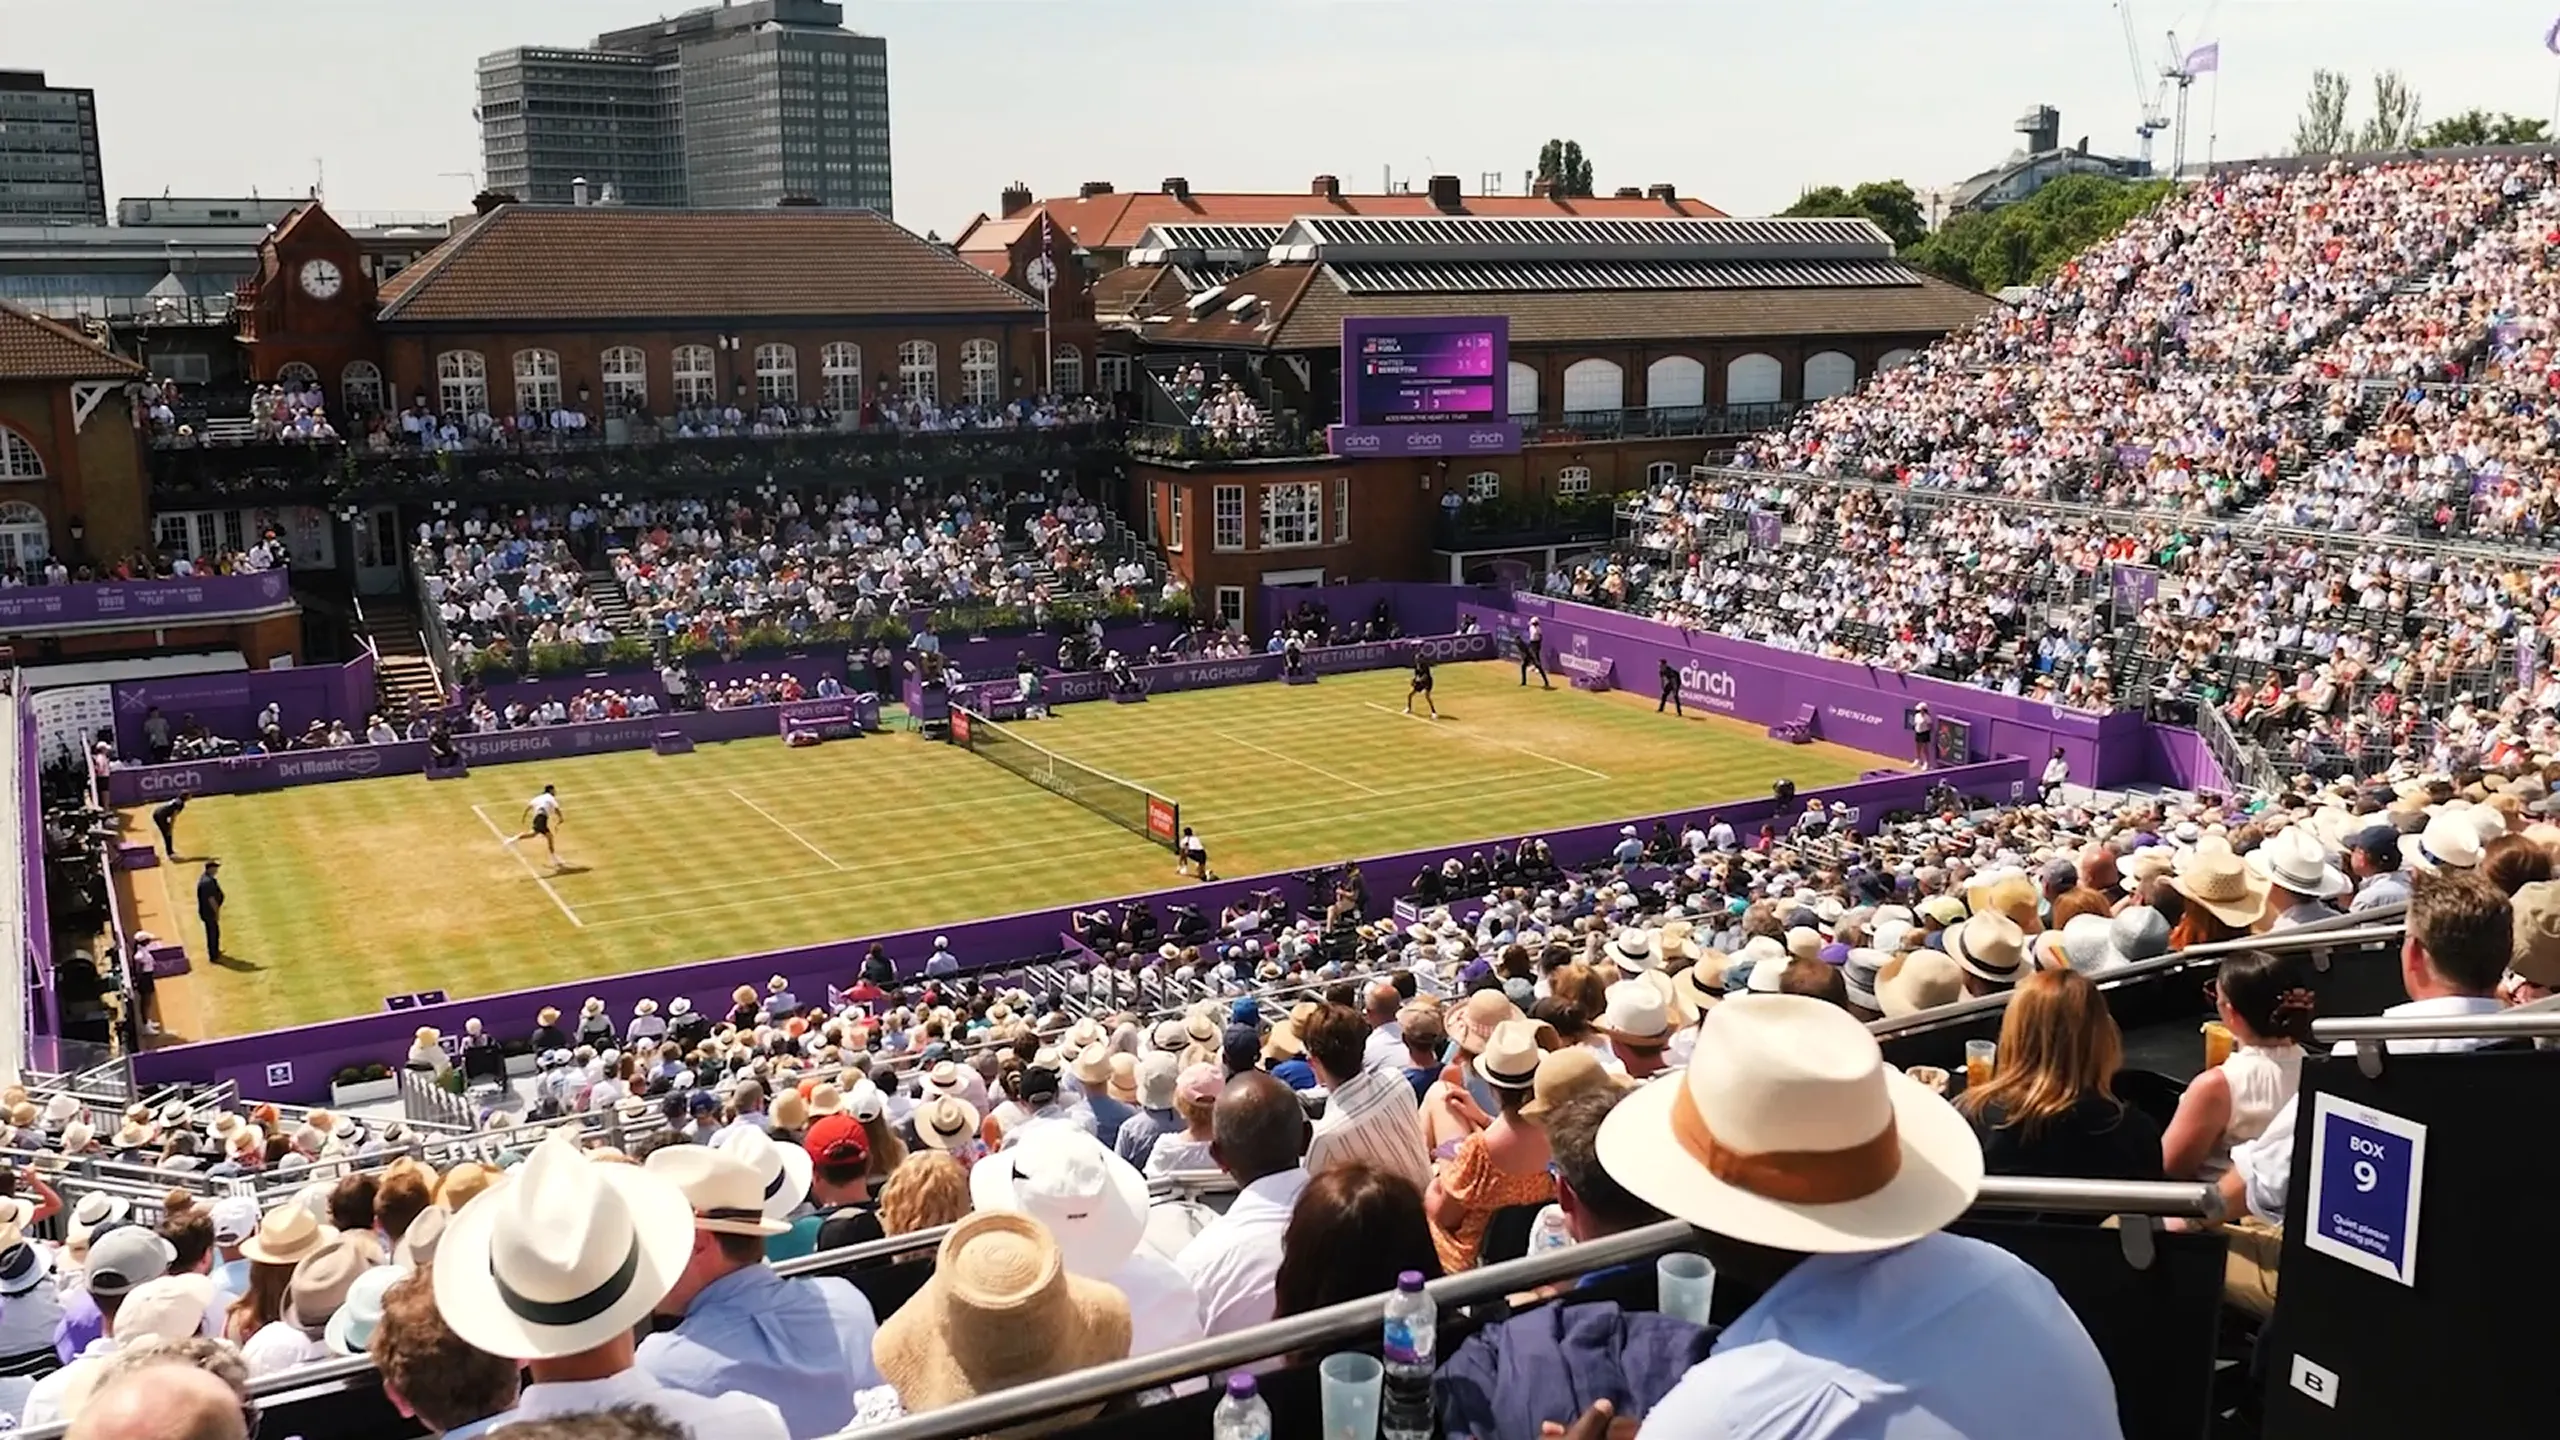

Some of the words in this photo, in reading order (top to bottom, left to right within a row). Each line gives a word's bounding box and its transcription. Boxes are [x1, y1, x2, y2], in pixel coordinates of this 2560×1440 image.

[1345, 433, 1380, 447] cinch
[1407, 431, 1442, 446] cinch
[1469, 430, 1504, 445] cinch
[1302, 646, 1386, 666] NYETIMBER
[1421, 636, 1486, 660] oppo
[1680, 659, 1735, 698] cinch
[1679, 689, 1734, 711] CHAMPIONSHIPS
[1837, 708, 1883, 725] DUNLOP
[480, 736, 551, 755] SUPERGA
[279, 761, 301, 778] Del
[302, 758, 345, 775] Monte
[140, 769, 202, 790] cinch
[2350, 1135, 2385, 1160] BOX
[2353, 1160, 2379, 1193] 9
[2333, 1213, 2357, 1230] Quiet
[2358, 1224, 2390, 1242] please
[2334, 1226, 2363, 1245] during
[2305, 1371, 2323, 1391] B
